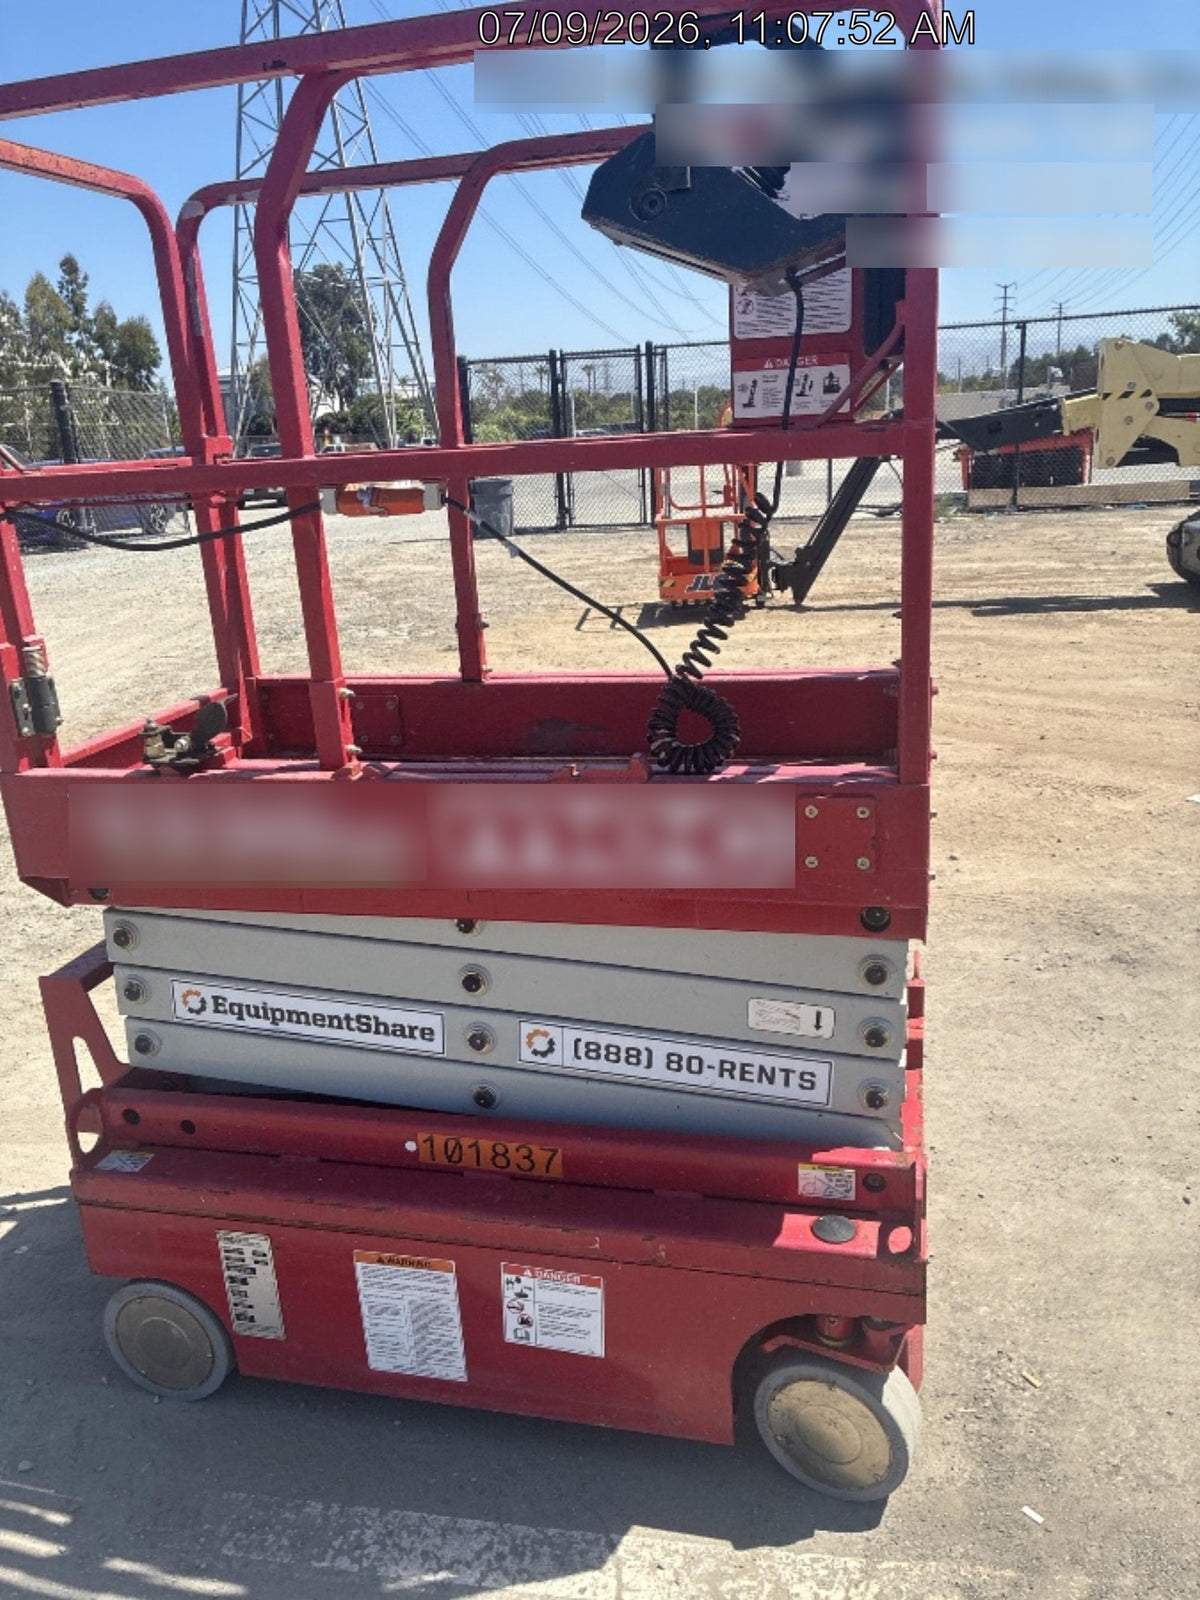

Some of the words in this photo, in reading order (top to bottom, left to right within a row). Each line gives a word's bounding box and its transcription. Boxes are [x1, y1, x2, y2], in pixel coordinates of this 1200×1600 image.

[775, 355, 818, 367] DAGER
[211, 995, 436, 1042] EquipmentShare
[573, 1038, 654, 1070] (888)
[666, 1052, 817, 1091] 80-RENTS
[422, 1134, 559, 1174] 101837
[535, 1268, 580, 1285] DANGER
